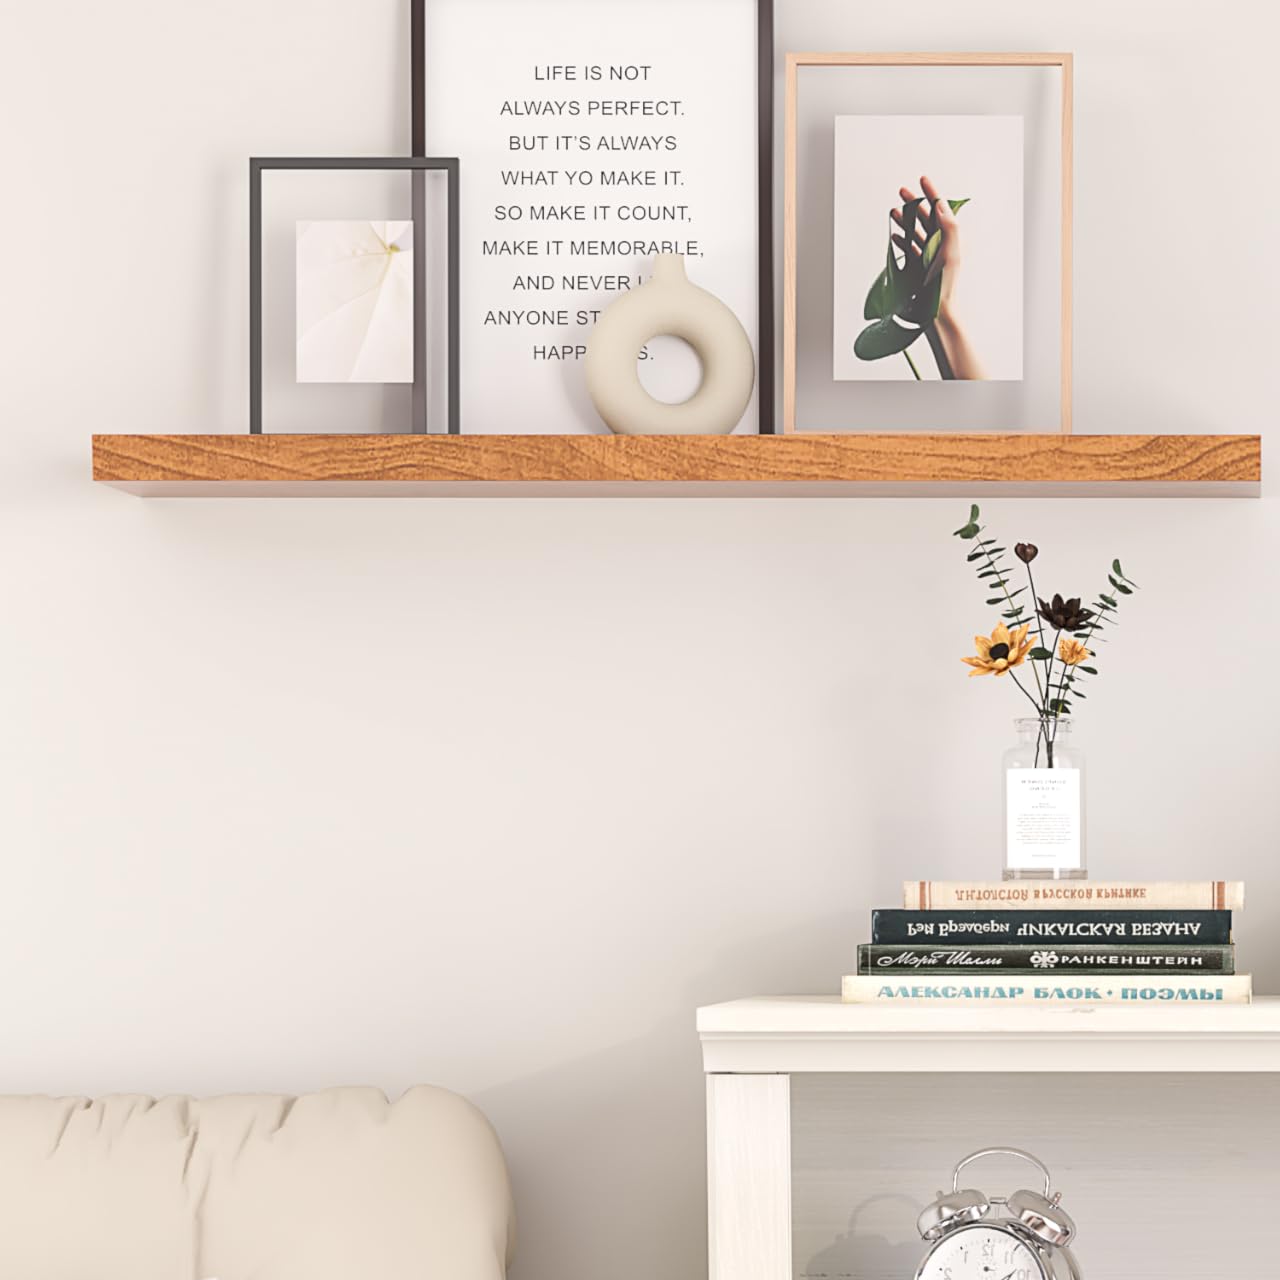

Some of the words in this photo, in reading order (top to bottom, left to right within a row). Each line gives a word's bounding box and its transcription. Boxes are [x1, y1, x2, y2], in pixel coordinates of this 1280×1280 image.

[534, 66, 577, 81] LIFE
[584, 66, 602, 81] IS
[609, 66, 652, 81] NOT
[500, 101, 581, 116] ALWAYS
[587, 101, 685, 116] PERFECT.
[508, 136, 549, 151] BUT
[555, 136, 591, 151] IT'S
[597, 136, 677, 151] ALWAYS
[501, 171, 558, 186] WHAT
[564, 171, 593, 186] YO
[599, 171, 657, 186] MAKE
[664, 171, 685, 186] IT.
[494, 206, 522, 221] SO
[530, 206, 586, 221] MAKE
[594, 206, 611, 221] IT
[617, 206, 692, 223] COUNT,
[482, 241, 538, 256] MAKE
[546, 241, 563, 256] IT
[512, 276, 555, 291] AND
[562, 276, 631, 291] NEVER
[484, 311, 569, 326] ANYONE
[877, 985, 1025, 999] АЛЕКСАНДР
[1033, 986, 1102, 1000] БЛОК
[1121, 987, 1224, 1001] ПОЭМЫ
